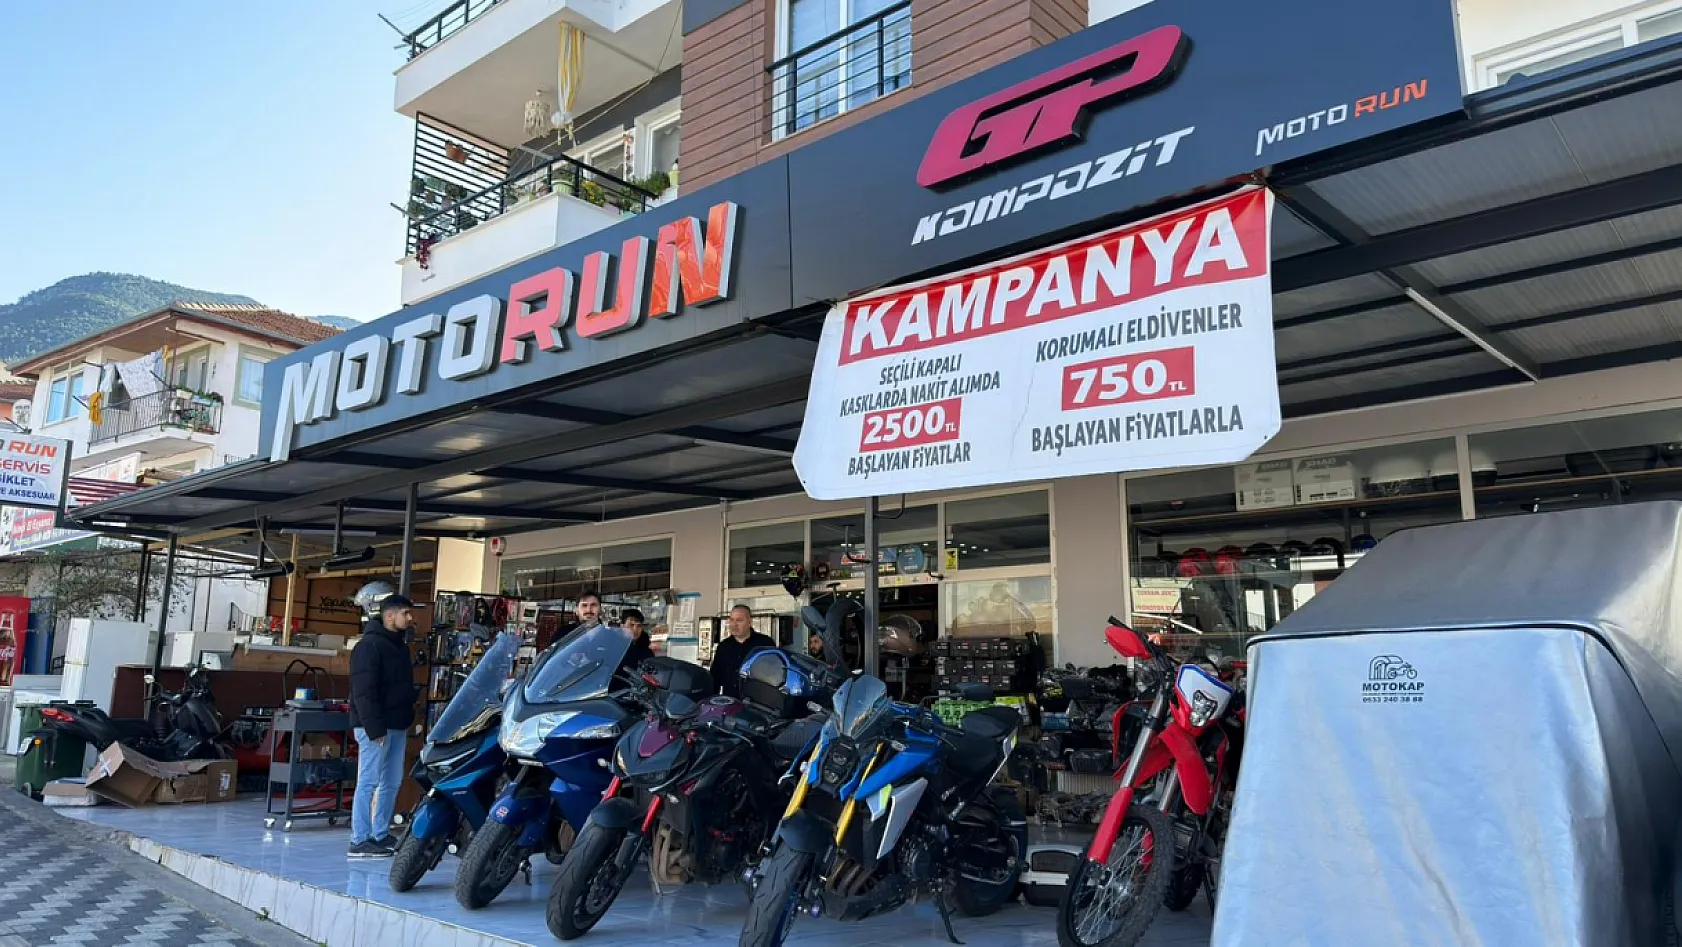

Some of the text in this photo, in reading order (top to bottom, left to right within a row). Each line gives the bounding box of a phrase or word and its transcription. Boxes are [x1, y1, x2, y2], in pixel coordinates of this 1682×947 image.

[848, 206, 1250, 356] KAMPANYA
[1035, 303, 1243, 363] KORUMALI ELDİVENLER
[879, 353, 962, 388] SEÇİLİ KAPALI
[840, 370, 1001, 417] KASKLARDA NAKİT ALIMDA
[8, 440, 58, 458] RUN
[1031, 417, 1121, 457] BAŞLAYAN
[847, 449, 910, 479] BAŞLAYAN
[8, 488, 55, 501] AKSESUAR
[1362, 681, 1425, 691] MOTOKAP
